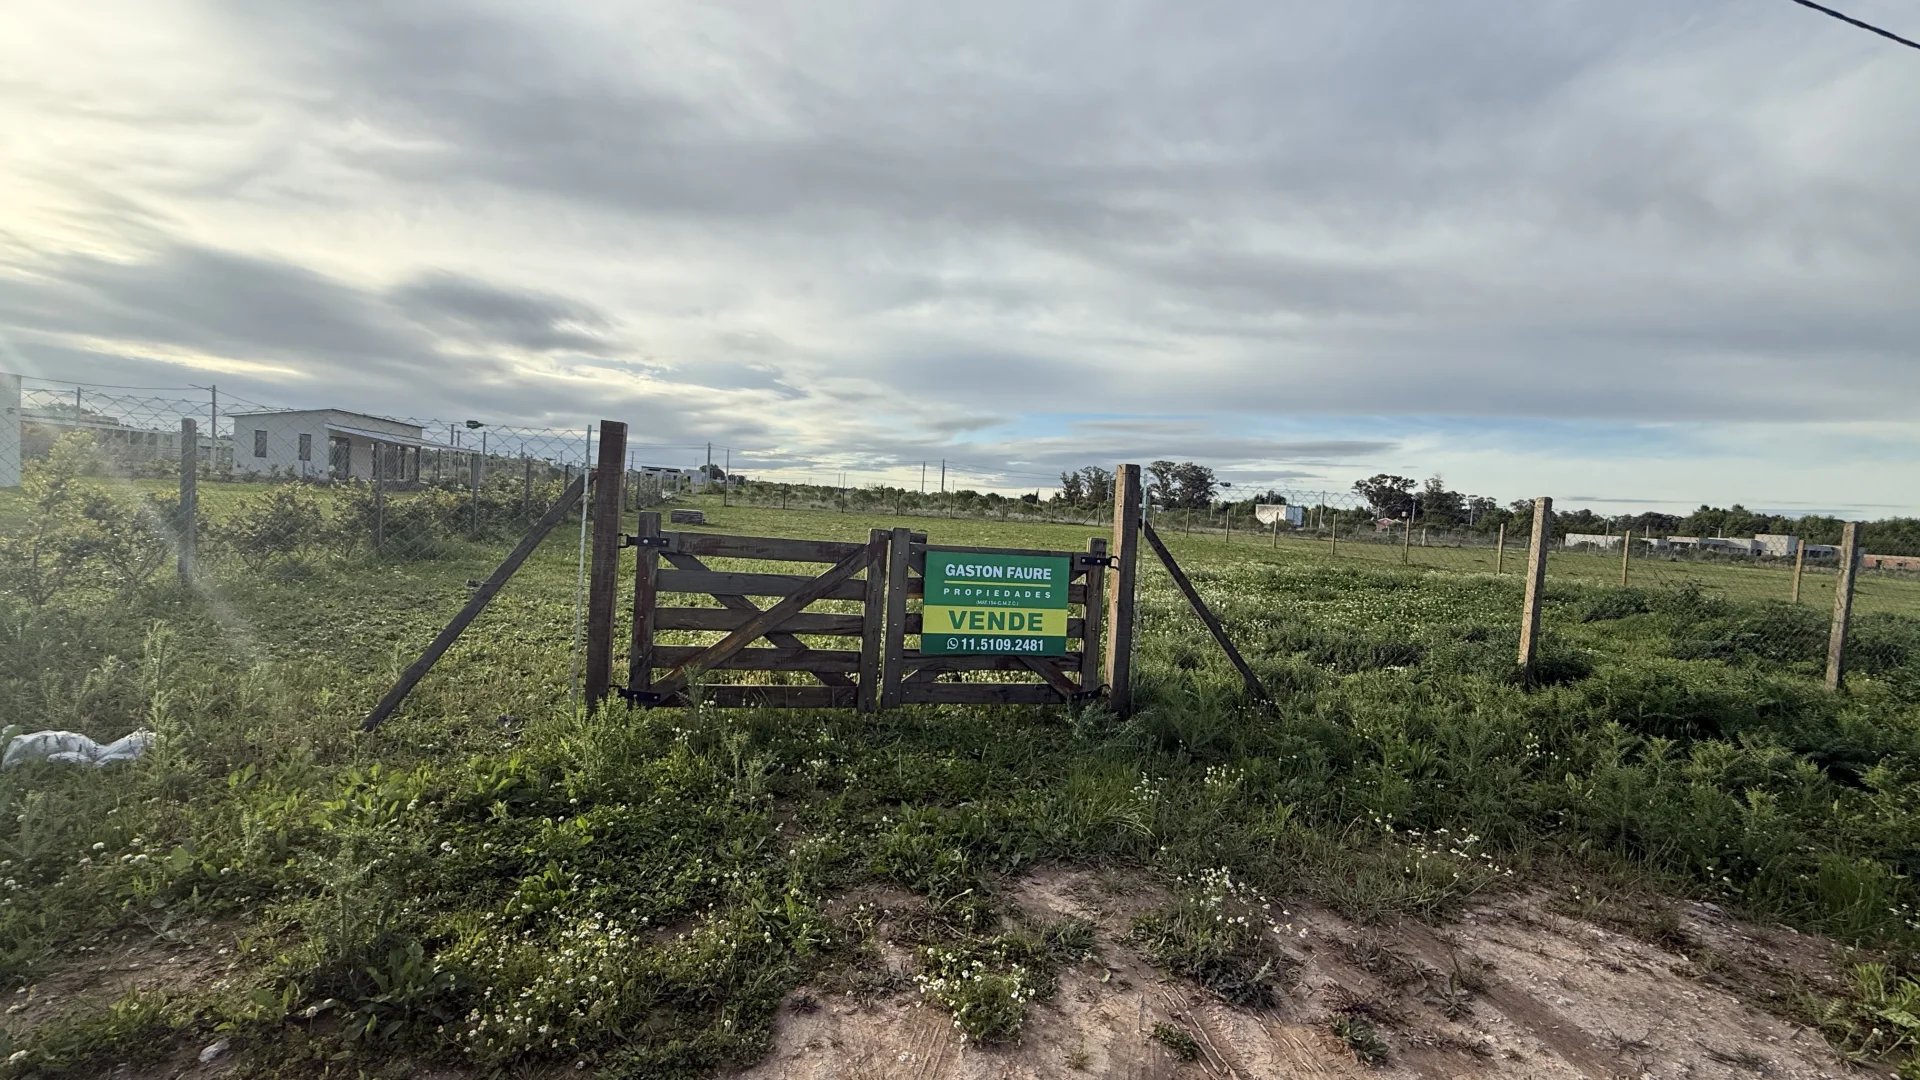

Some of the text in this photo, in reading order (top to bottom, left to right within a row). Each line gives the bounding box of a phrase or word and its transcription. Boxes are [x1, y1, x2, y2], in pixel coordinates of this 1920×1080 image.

[945, 563, 1052, 580] GASTON FAURE
[943, 588, 1051, 599] PROPIEDADES
[948, 610, 1043, 632] VENDE
[961, 638, 1044, 652] 11.5109.2481
